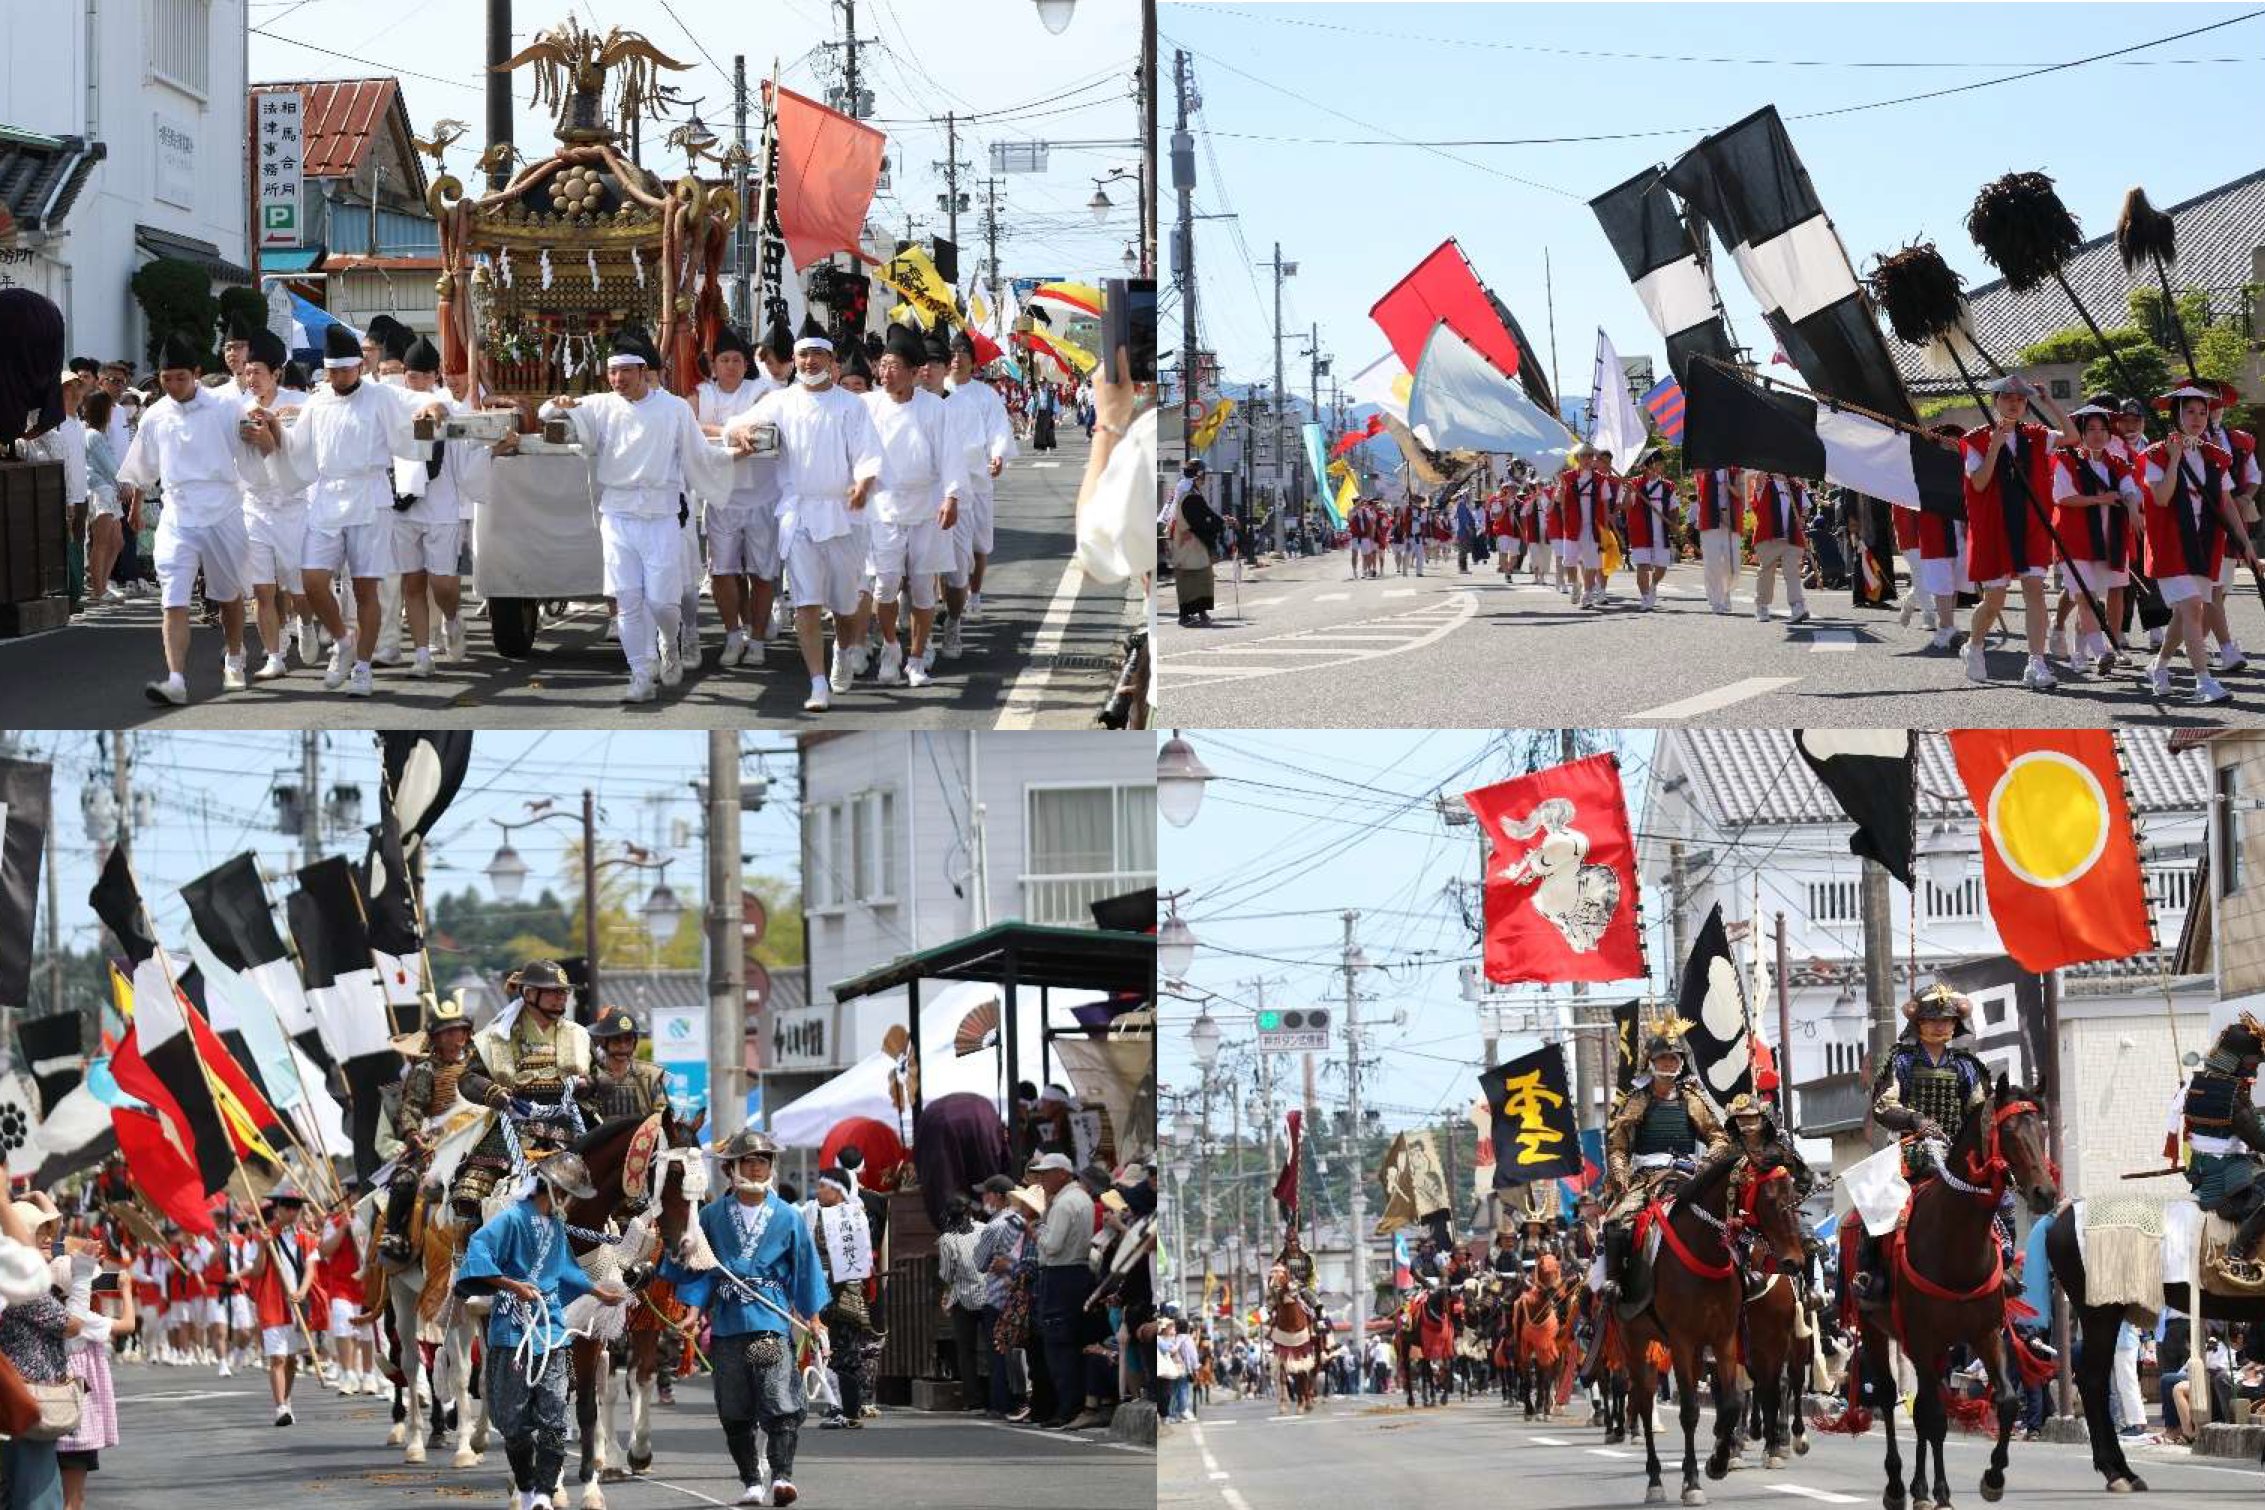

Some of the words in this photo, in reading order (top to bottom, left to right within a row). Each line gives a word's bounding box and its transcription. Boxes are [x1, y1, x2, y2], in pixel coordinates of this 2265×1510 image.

[263, 102, 280, 197] 法律事務所
[269, 208, 289, 226] P
